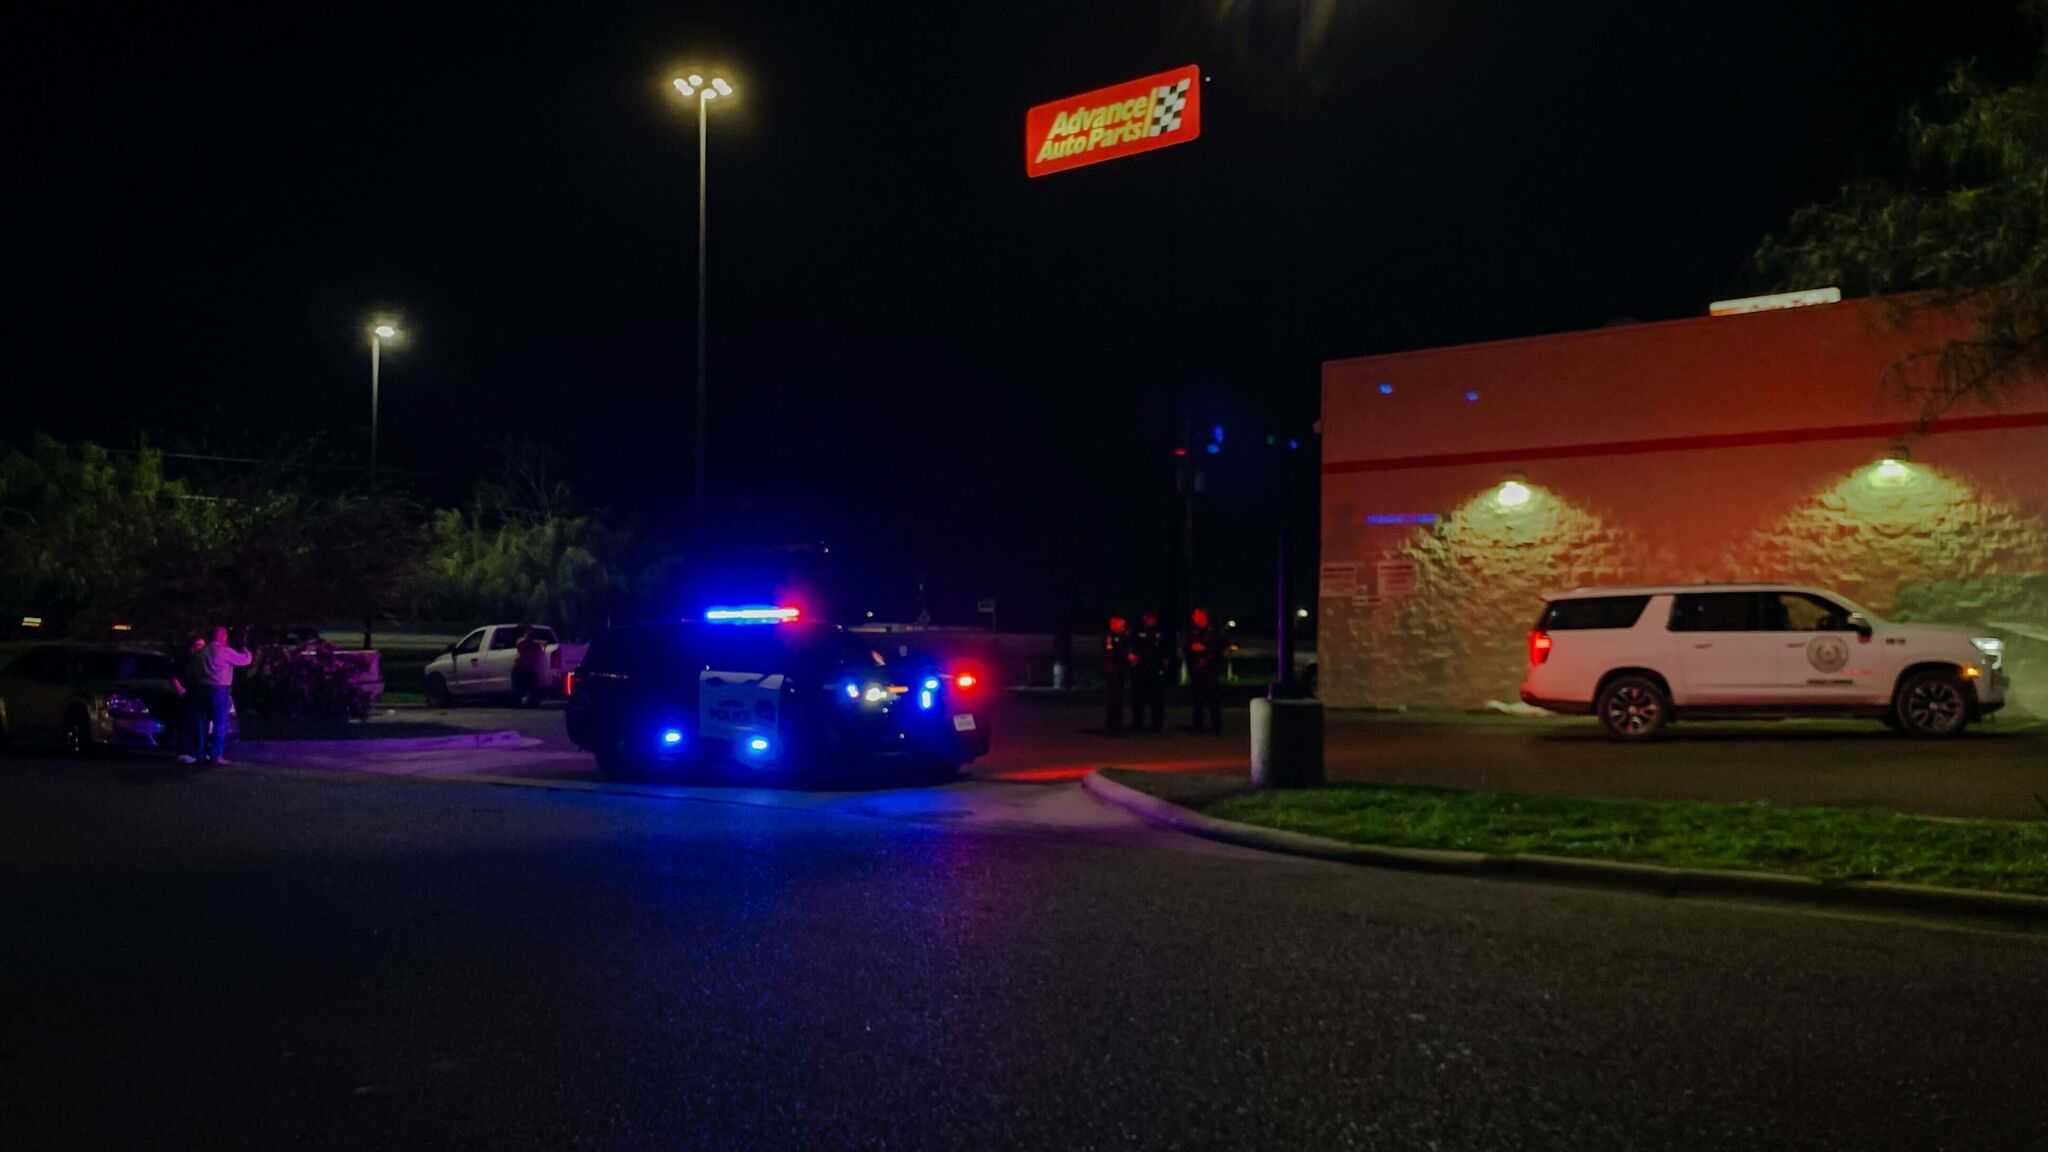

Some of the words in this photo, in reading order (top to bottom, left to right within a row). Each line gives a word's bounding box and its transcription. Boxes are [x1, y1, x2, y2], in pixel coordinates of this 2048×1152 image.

[1047, 96, 1148, 139] Advance
[1035, 134, 1086, 164] Auto
[1086, 120, 1145, 152] Parts
[710, 708, 753, 723] POLICE
